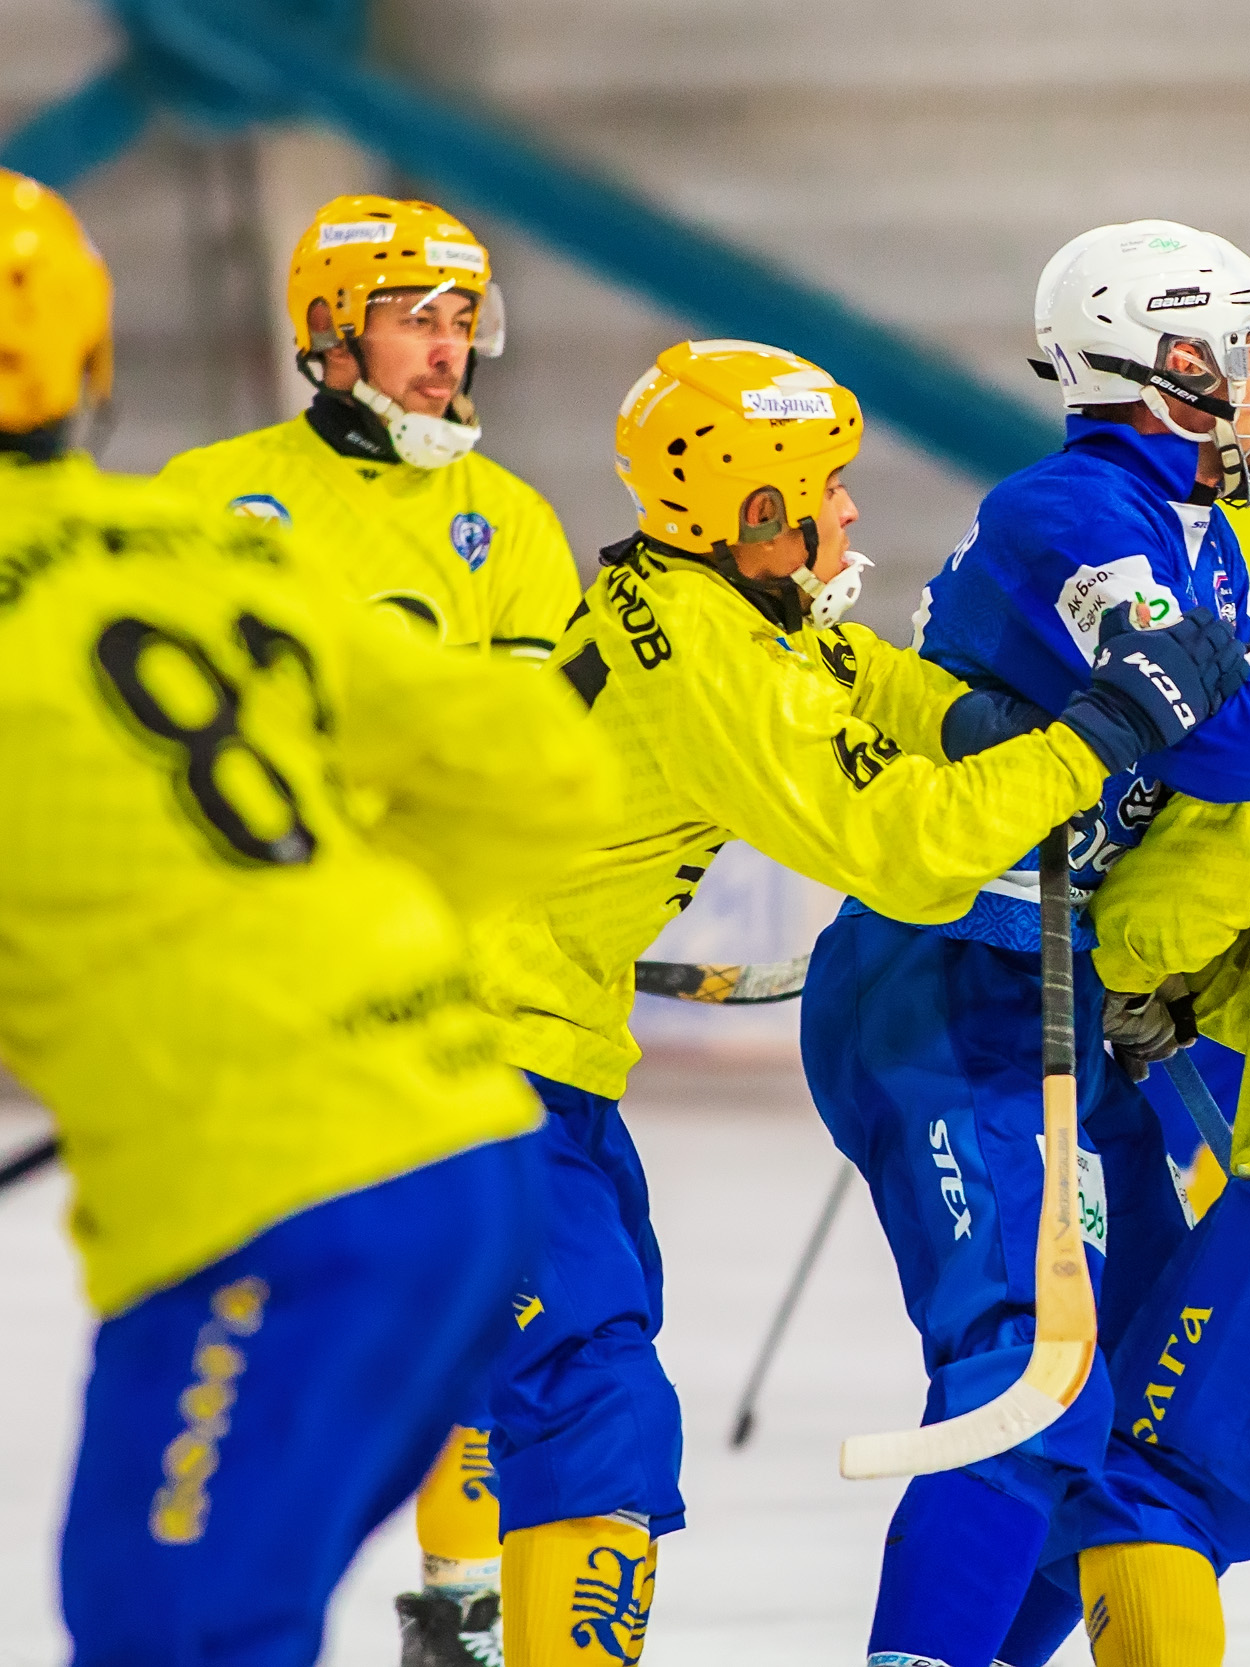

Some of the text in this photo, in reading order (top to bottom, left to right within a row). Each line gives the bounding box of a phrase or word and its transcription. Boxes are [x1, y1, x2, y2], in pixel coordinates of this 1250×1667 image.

[1149, 293, 1208, 310] BAUER
[1149, 374, 1200, 403] BAUER
[1077, 594, 1107, 633] Банк
[1122, 651, 1198, 731] CCM
[929, 1119, 972, 1241] STEX
